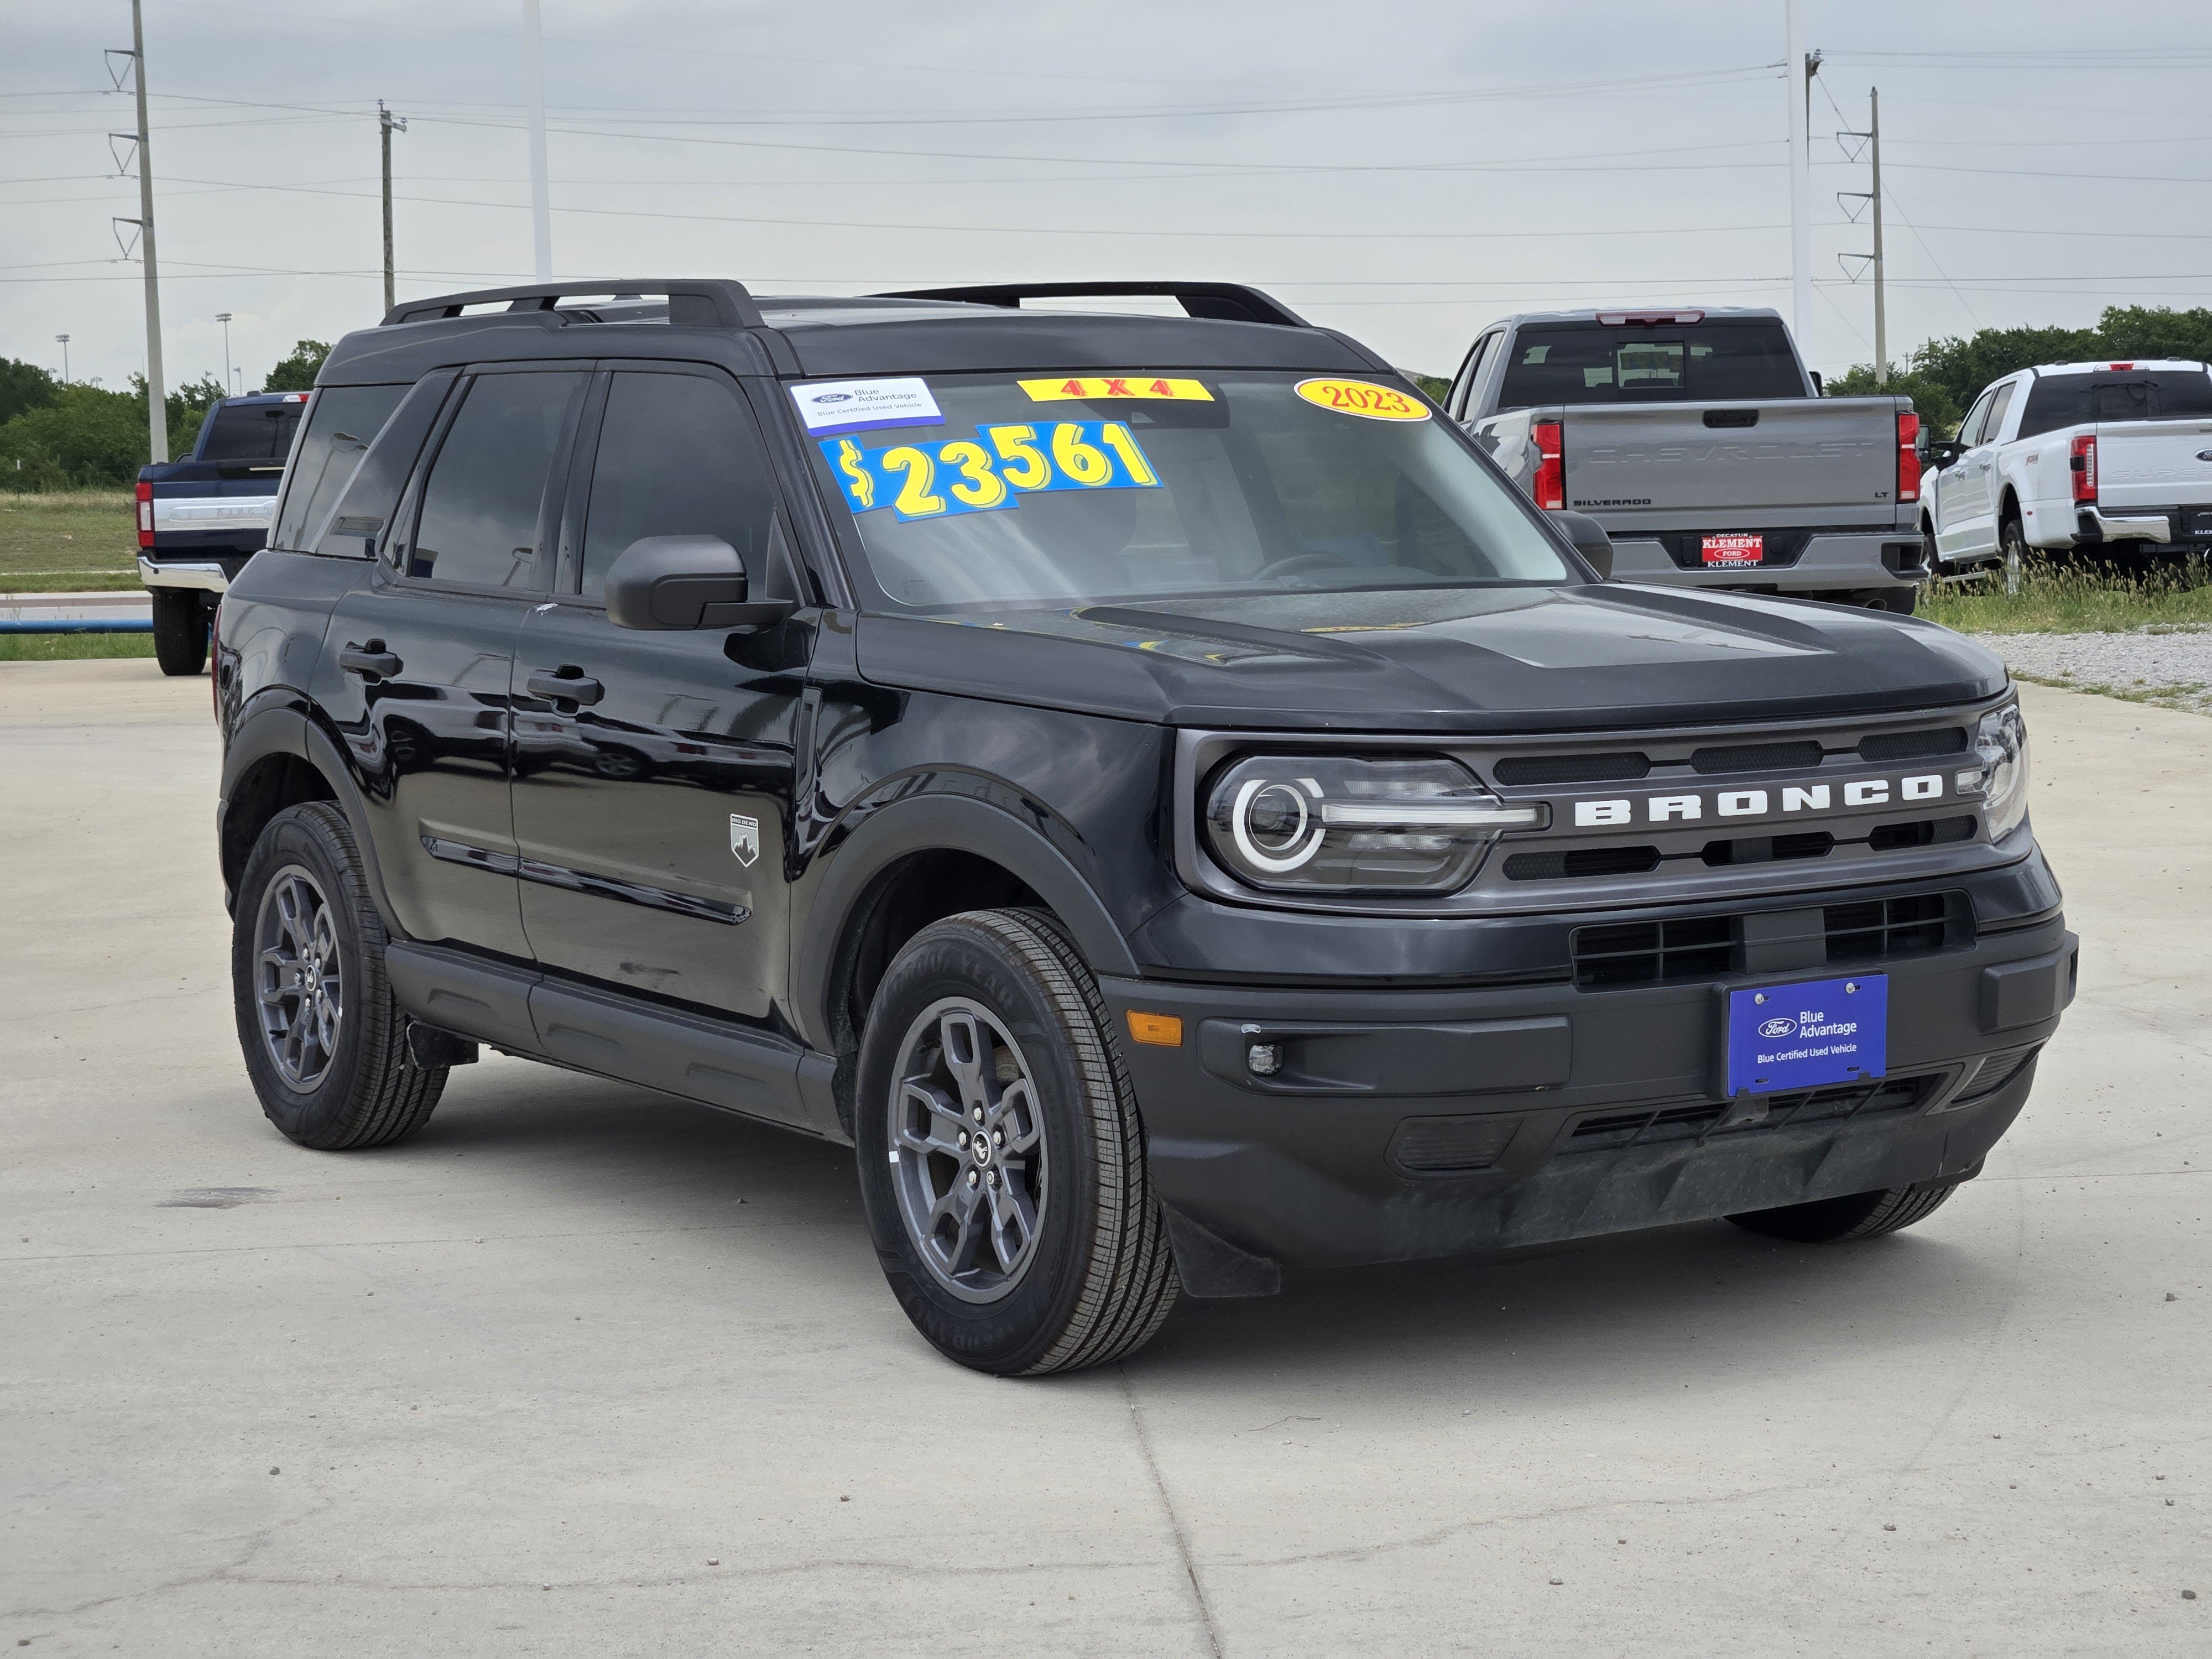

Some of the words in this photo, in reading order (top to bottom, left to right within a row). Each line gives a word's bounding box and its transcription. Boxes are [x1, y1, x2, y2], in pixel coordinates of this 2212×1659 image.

[858, 393, 917, 403] Advantage
[1323, 386, 1411, 413] 2023
[838, 405, 870, 414] Certified
[838, 422, 1157, 517] $23561
[217, 508, 254, 517] KING
[1703, 539, 1762, 548] KLEMENT
[1575, 775, 1943, 826] BRONCO
[1800, 1010, 1824, 1024] Blue
[1766, 1020, 1790, 1035] Ford
[1799, 1022, 1857, 1039] Advantage
[1757, 1054, 1775, 1063] Blue
[1776, 1050, 1808, 1061] Certified
[1809, 1046, 1829, 1057] Used
[1830, 1044, 1857, 1055] Vehicle
